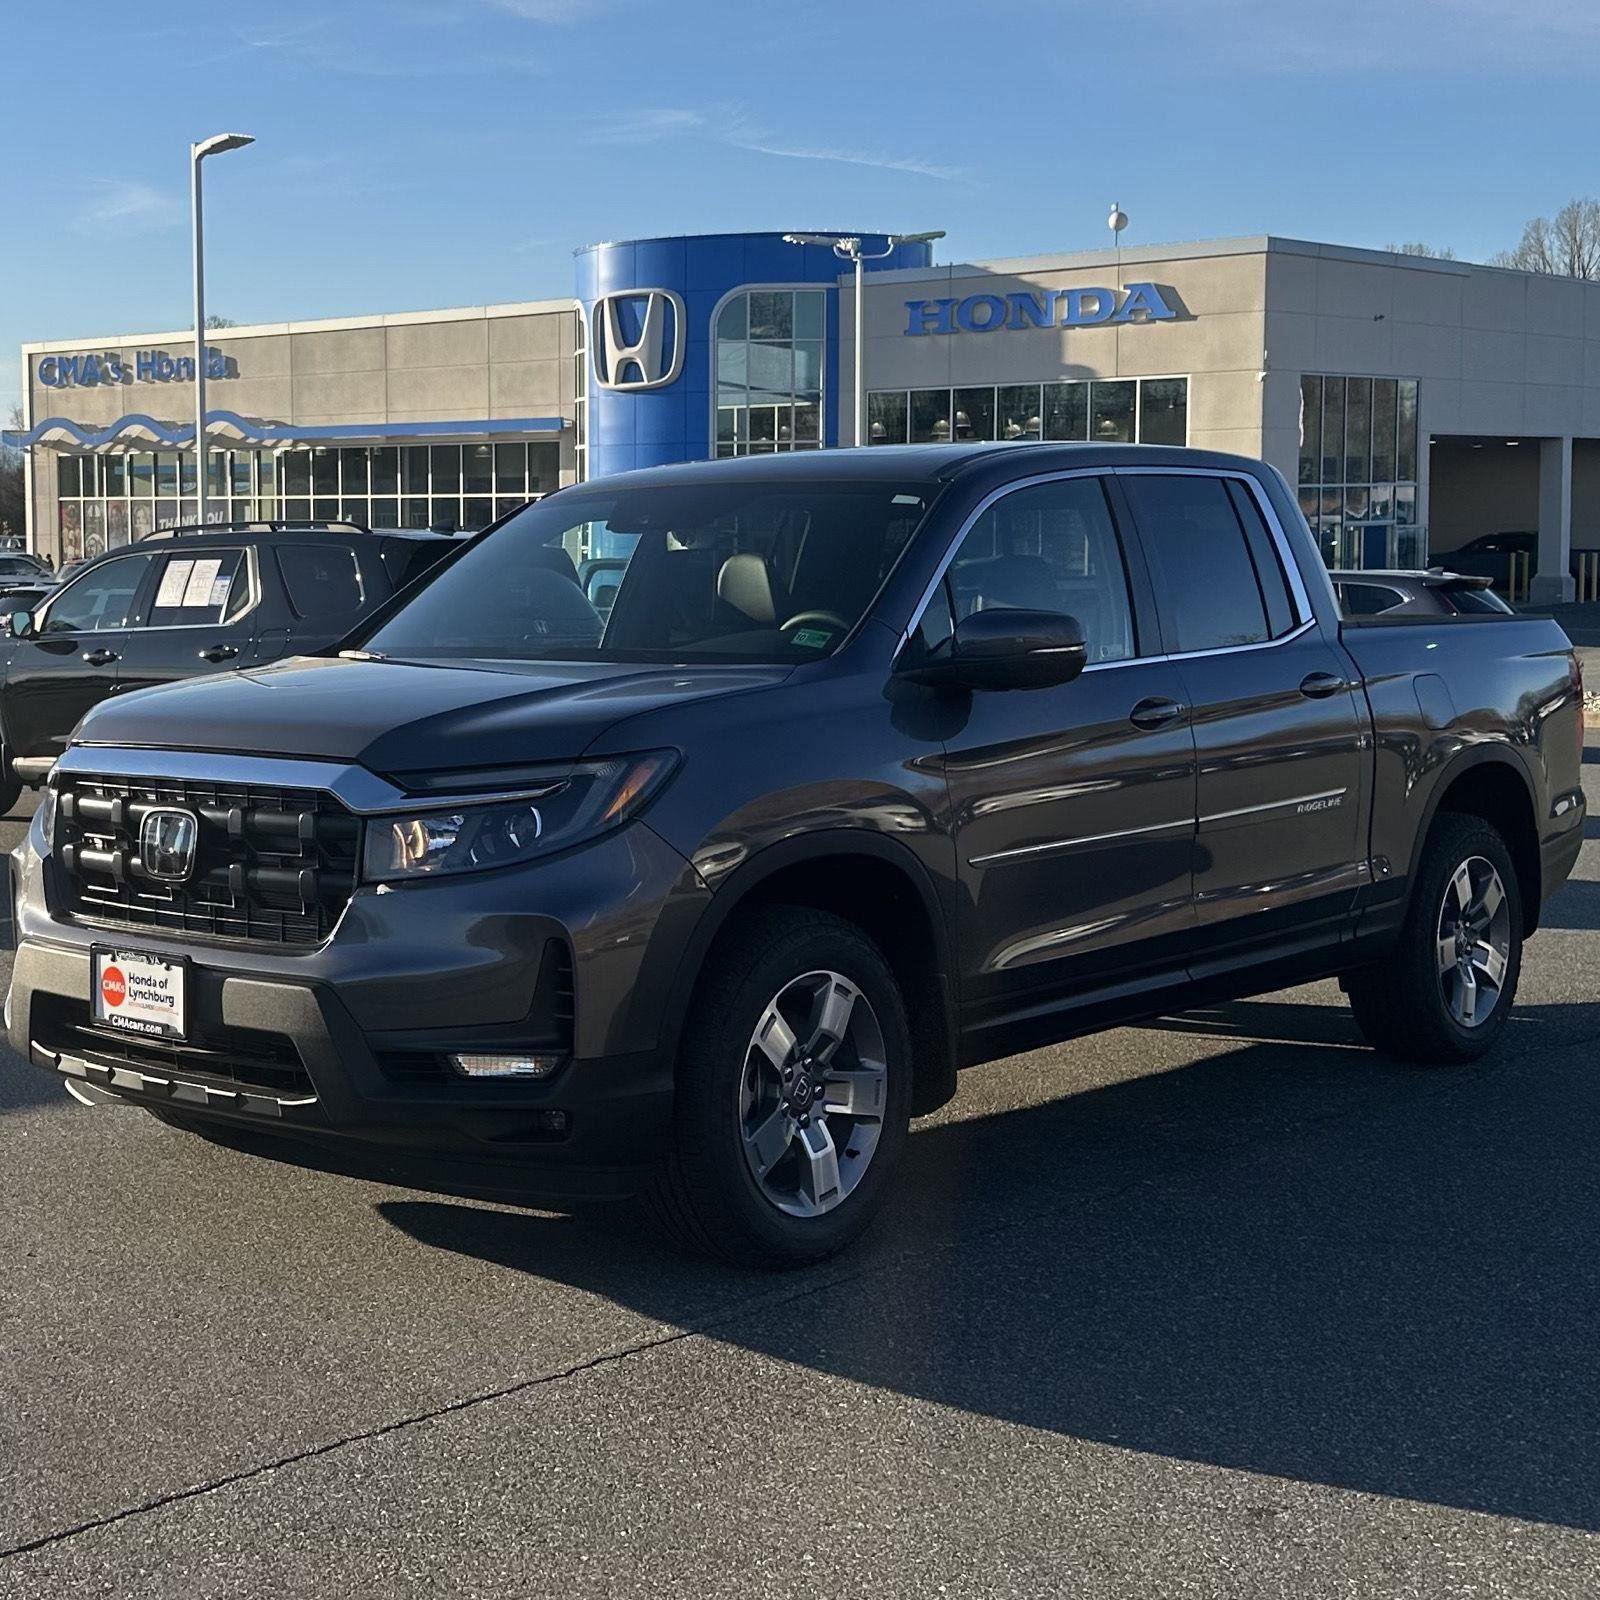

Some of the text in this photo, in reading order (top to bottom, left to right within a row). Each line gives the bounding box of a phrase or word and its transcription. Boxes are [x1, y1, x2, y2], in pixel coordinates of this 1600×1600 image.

[904, 282, 1176, 336] HONDA
[1297, 796, 1343, 813] RIDGELINE
[128, 972, 169, 990] Honda of
[128, 987, 175, 1007] Lynchburg
[112, 1015, 163, 1035] CMAcars.com
